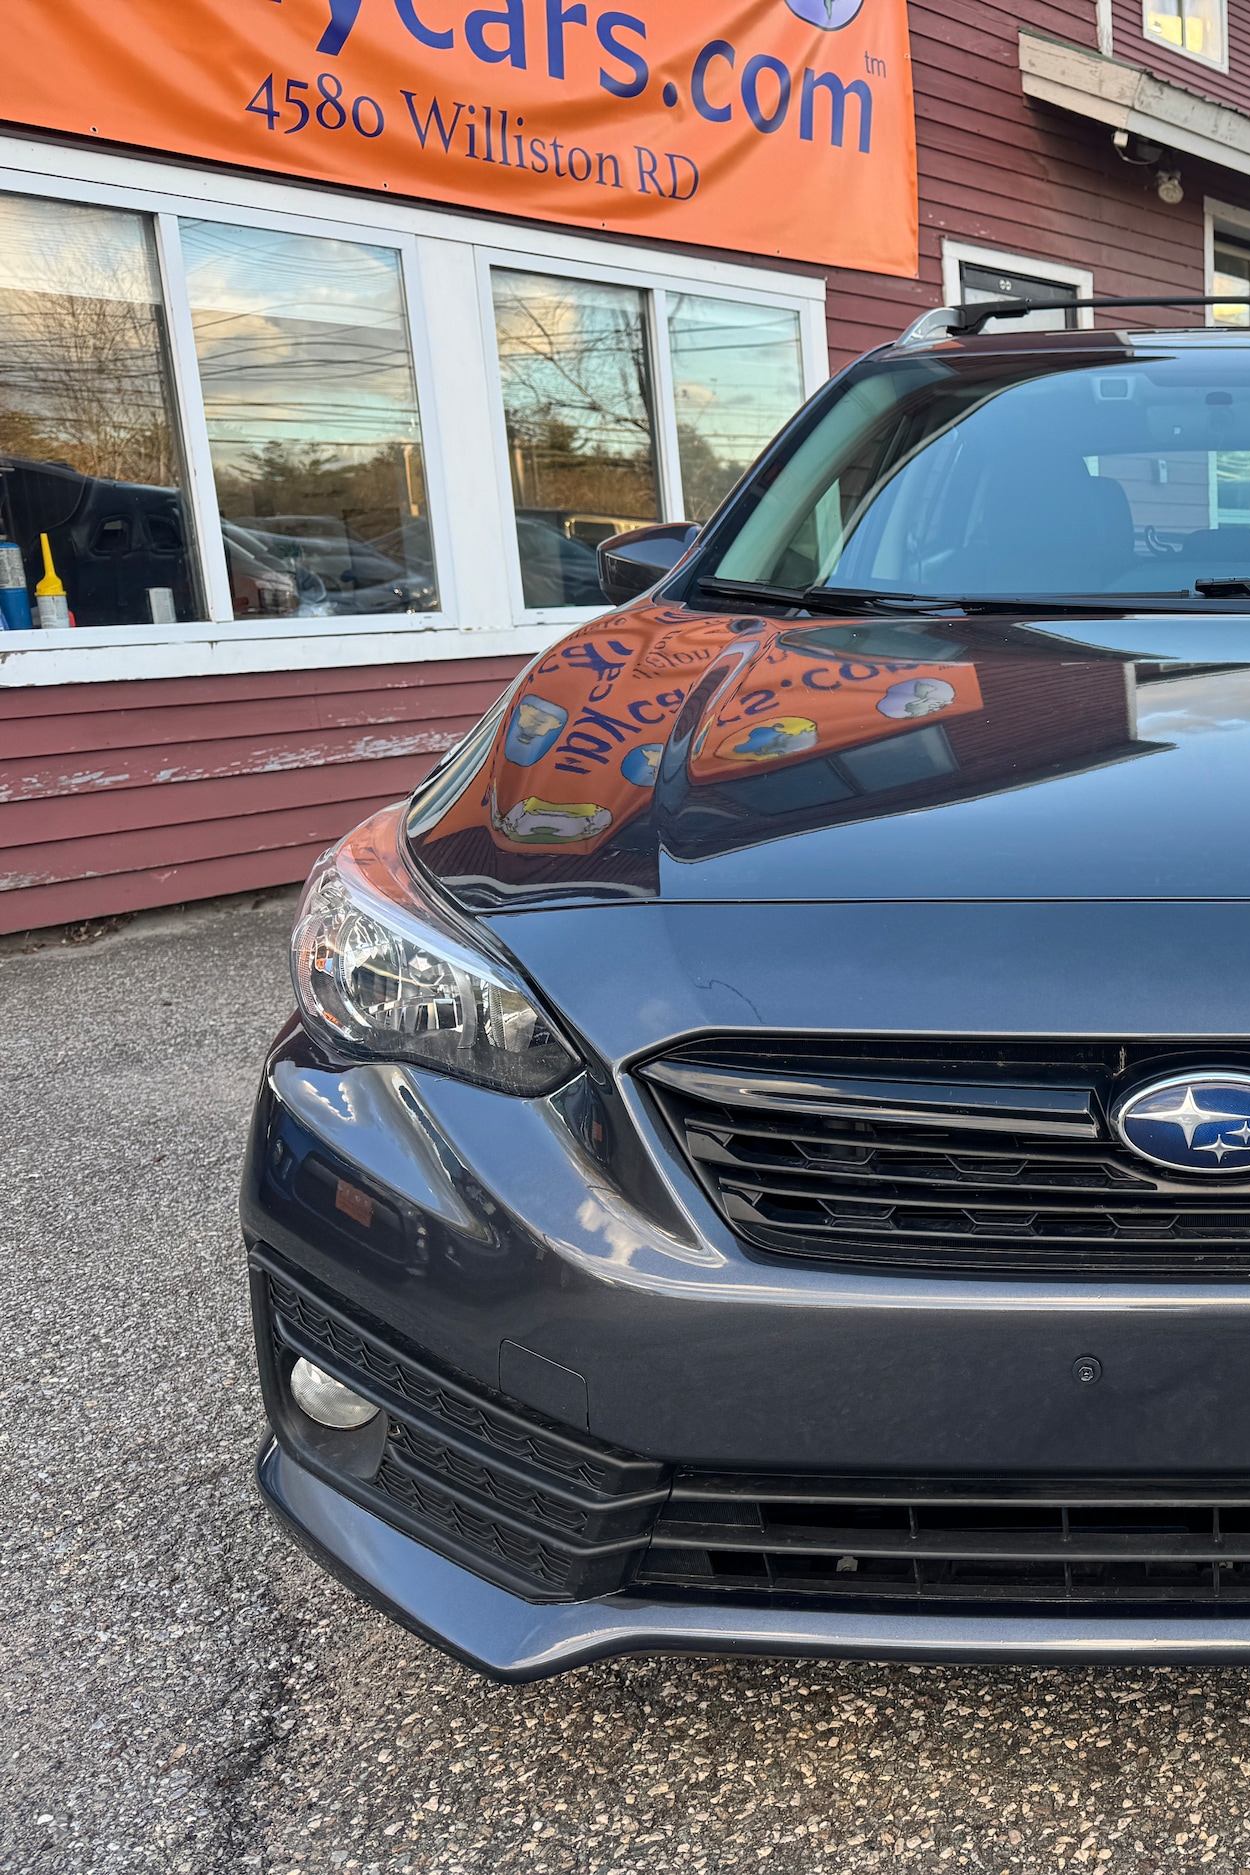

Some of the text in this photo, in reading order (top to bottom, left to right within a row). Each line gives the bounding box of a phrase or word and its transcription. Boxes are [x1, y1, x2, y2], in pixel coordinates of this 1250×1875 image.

[864, 50, 887, 79] tm
[244, 72, 699, 202] 4580 Williston RD
